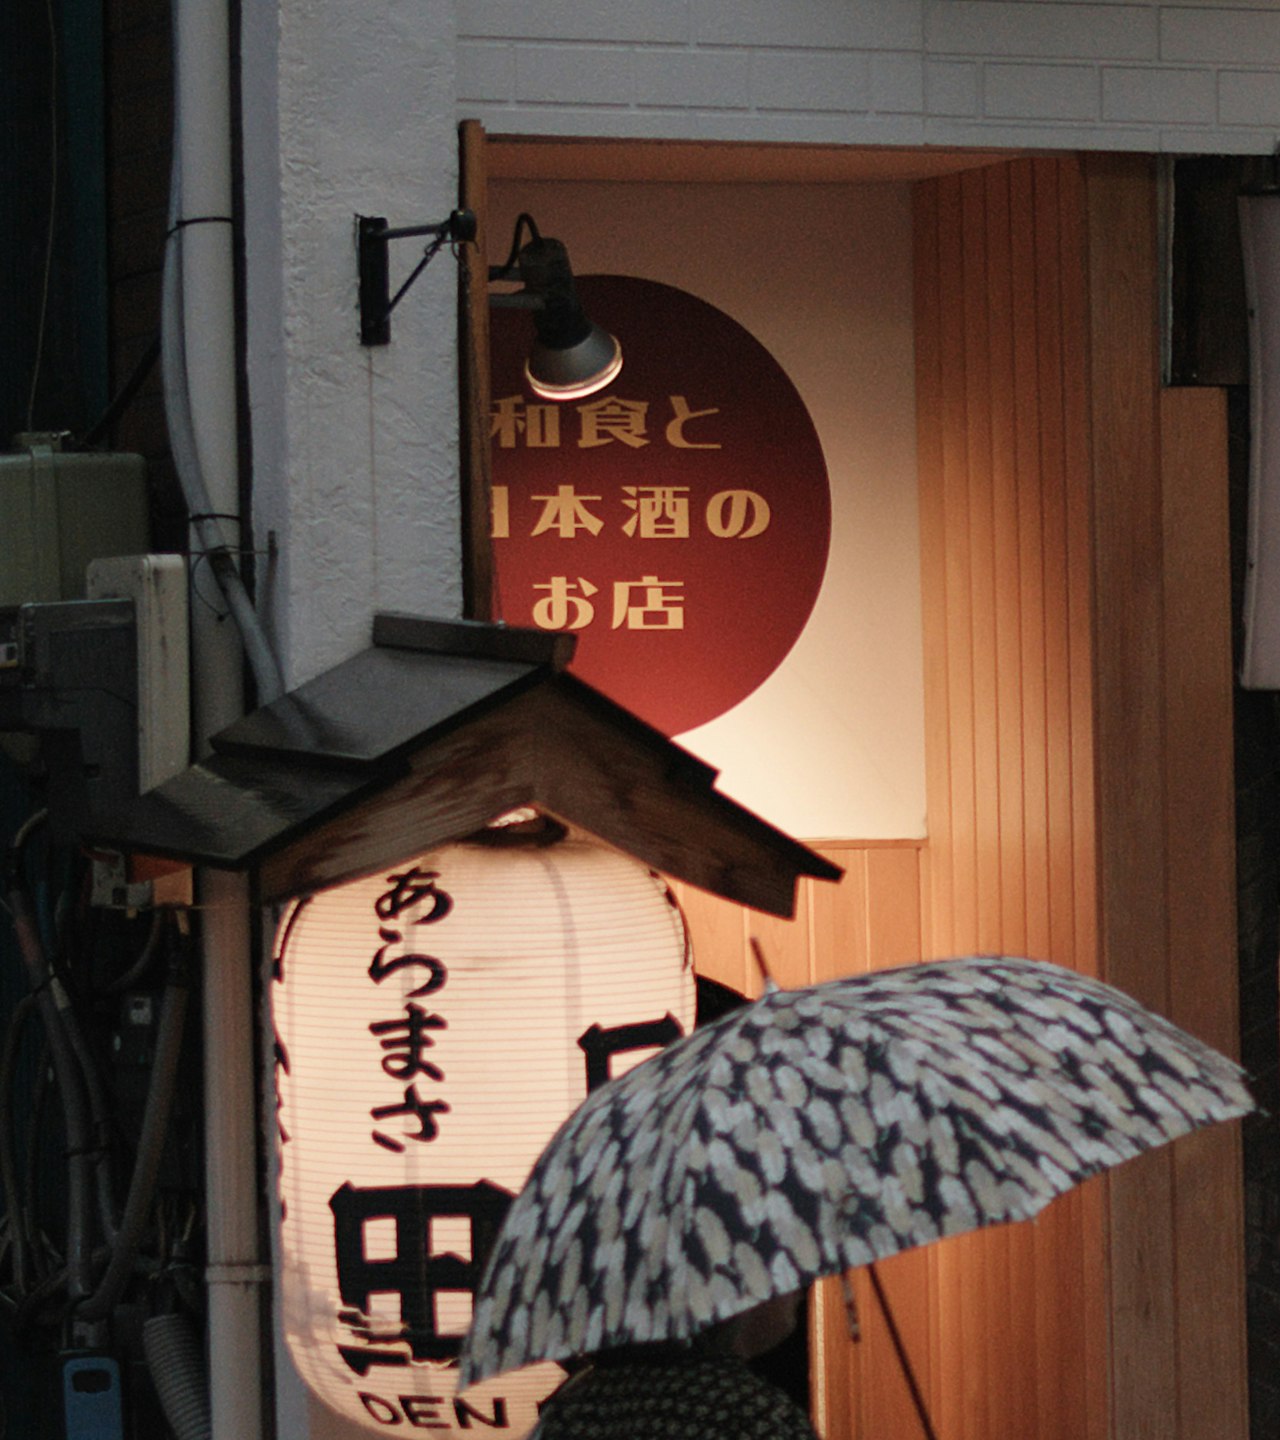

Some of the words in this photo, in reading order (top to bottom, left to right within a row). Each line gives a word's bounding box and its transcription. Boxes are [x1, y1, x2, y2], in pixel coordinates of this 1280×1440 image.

[489, 395, 722, 449] 和食と
[532, 575, 685, 631] お店
[368, 867, 454, 1153] あらまさ
[358, 1392, 510, 1428] DEN
